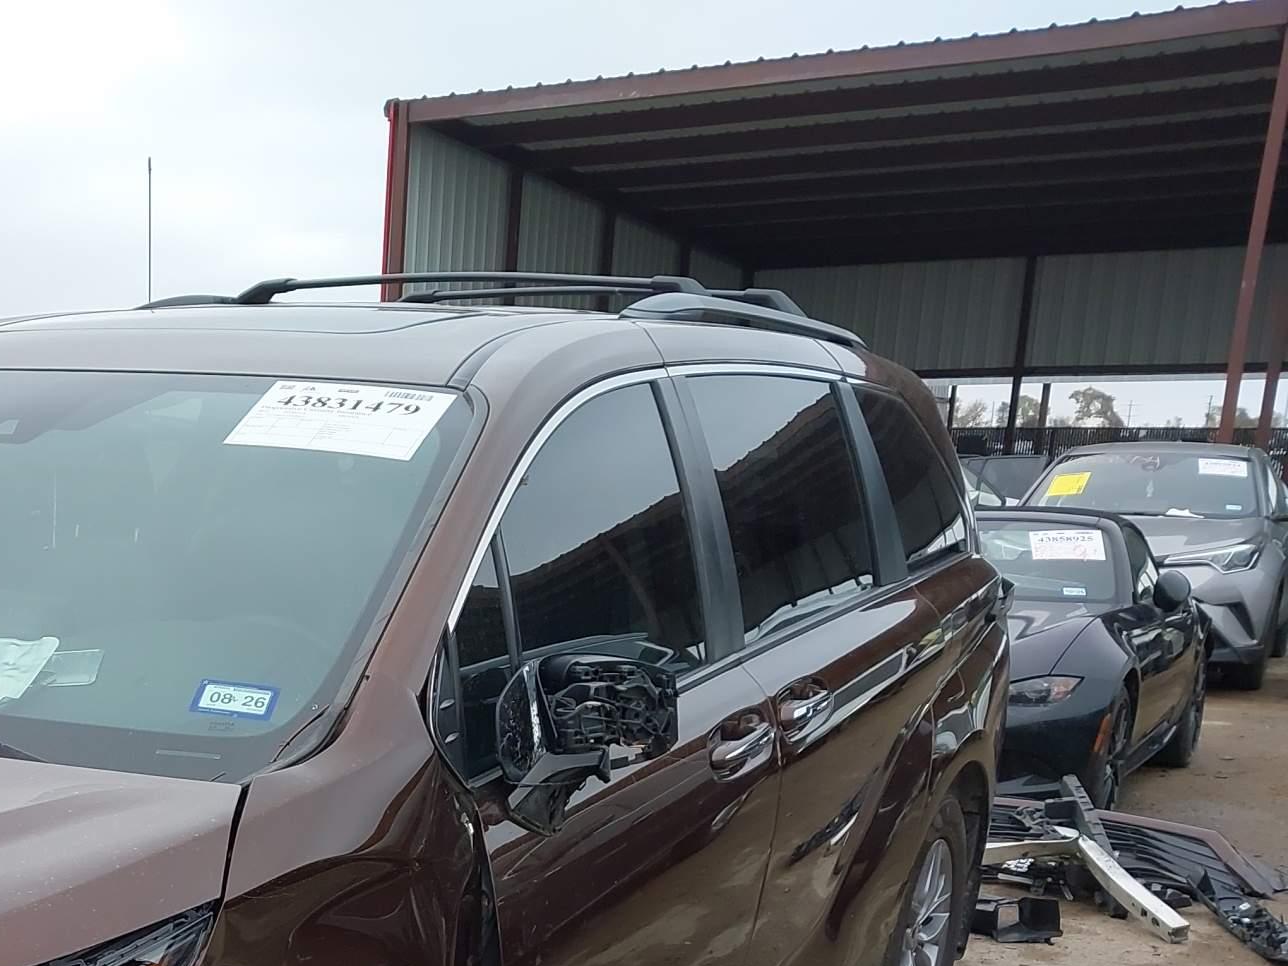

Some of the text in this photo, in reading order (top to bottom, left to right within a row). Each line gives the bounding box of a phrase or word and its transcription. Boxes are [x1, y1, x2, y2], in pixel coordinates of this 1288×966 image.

[276, 394, 421, 416] 43831479
[209, 691, 267, 709] 08 26
